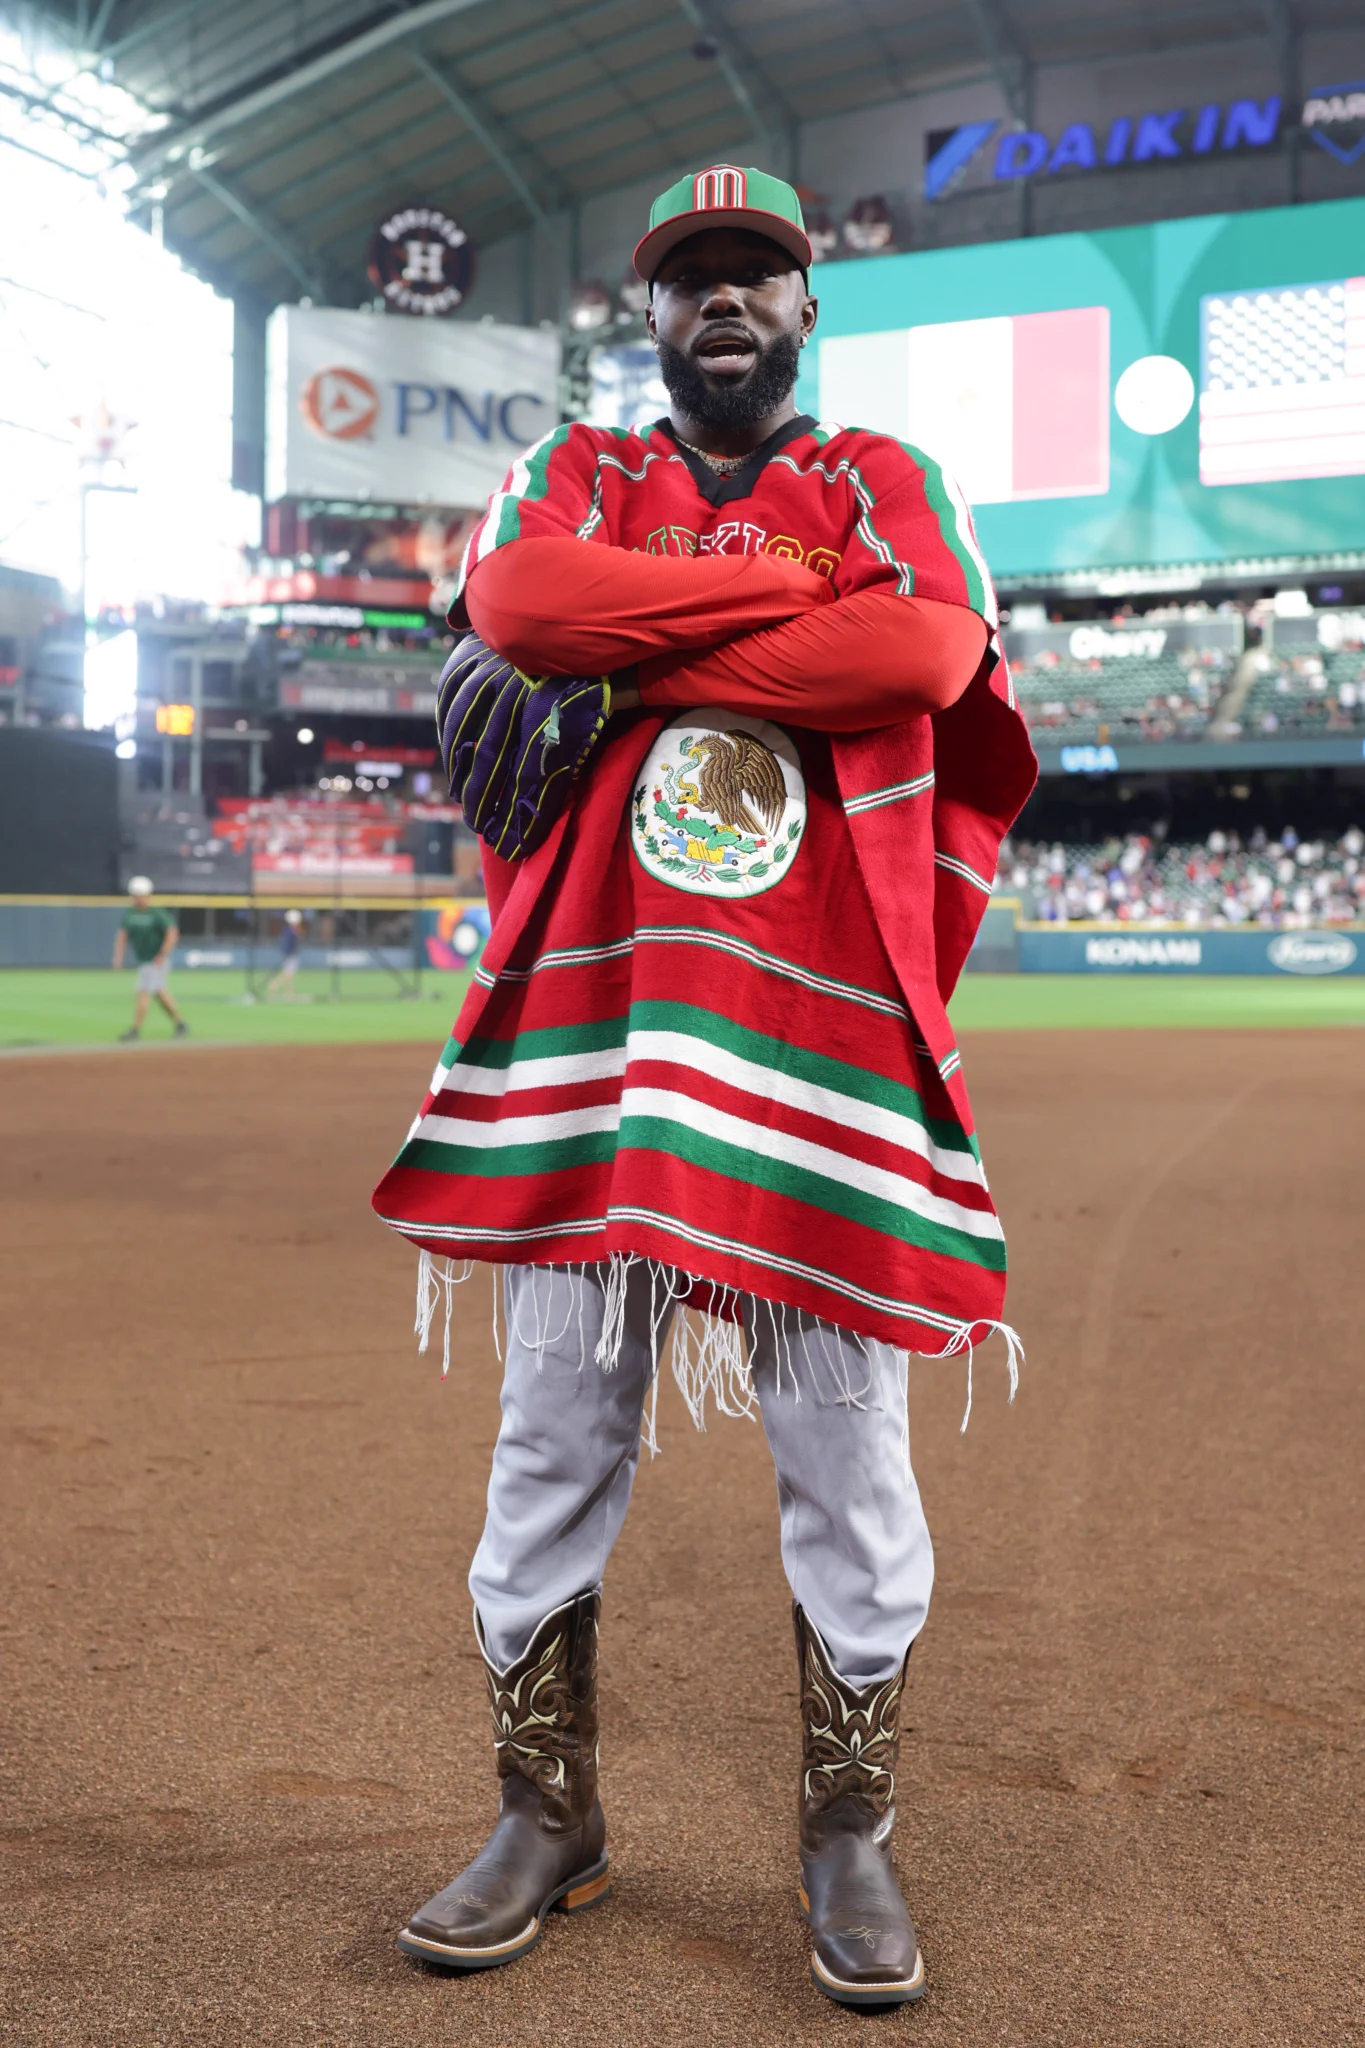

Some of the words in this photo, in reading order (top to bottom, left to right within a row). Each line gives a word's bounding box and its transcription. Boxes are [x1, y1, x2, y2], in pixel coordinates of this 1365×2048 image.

[993, 95, 1282, 179] DAIKIN
[402, 240, 445, 283] H
[392, 381, 547, 446] PNC
[1086, 938, 1201, 966] KONAMI
